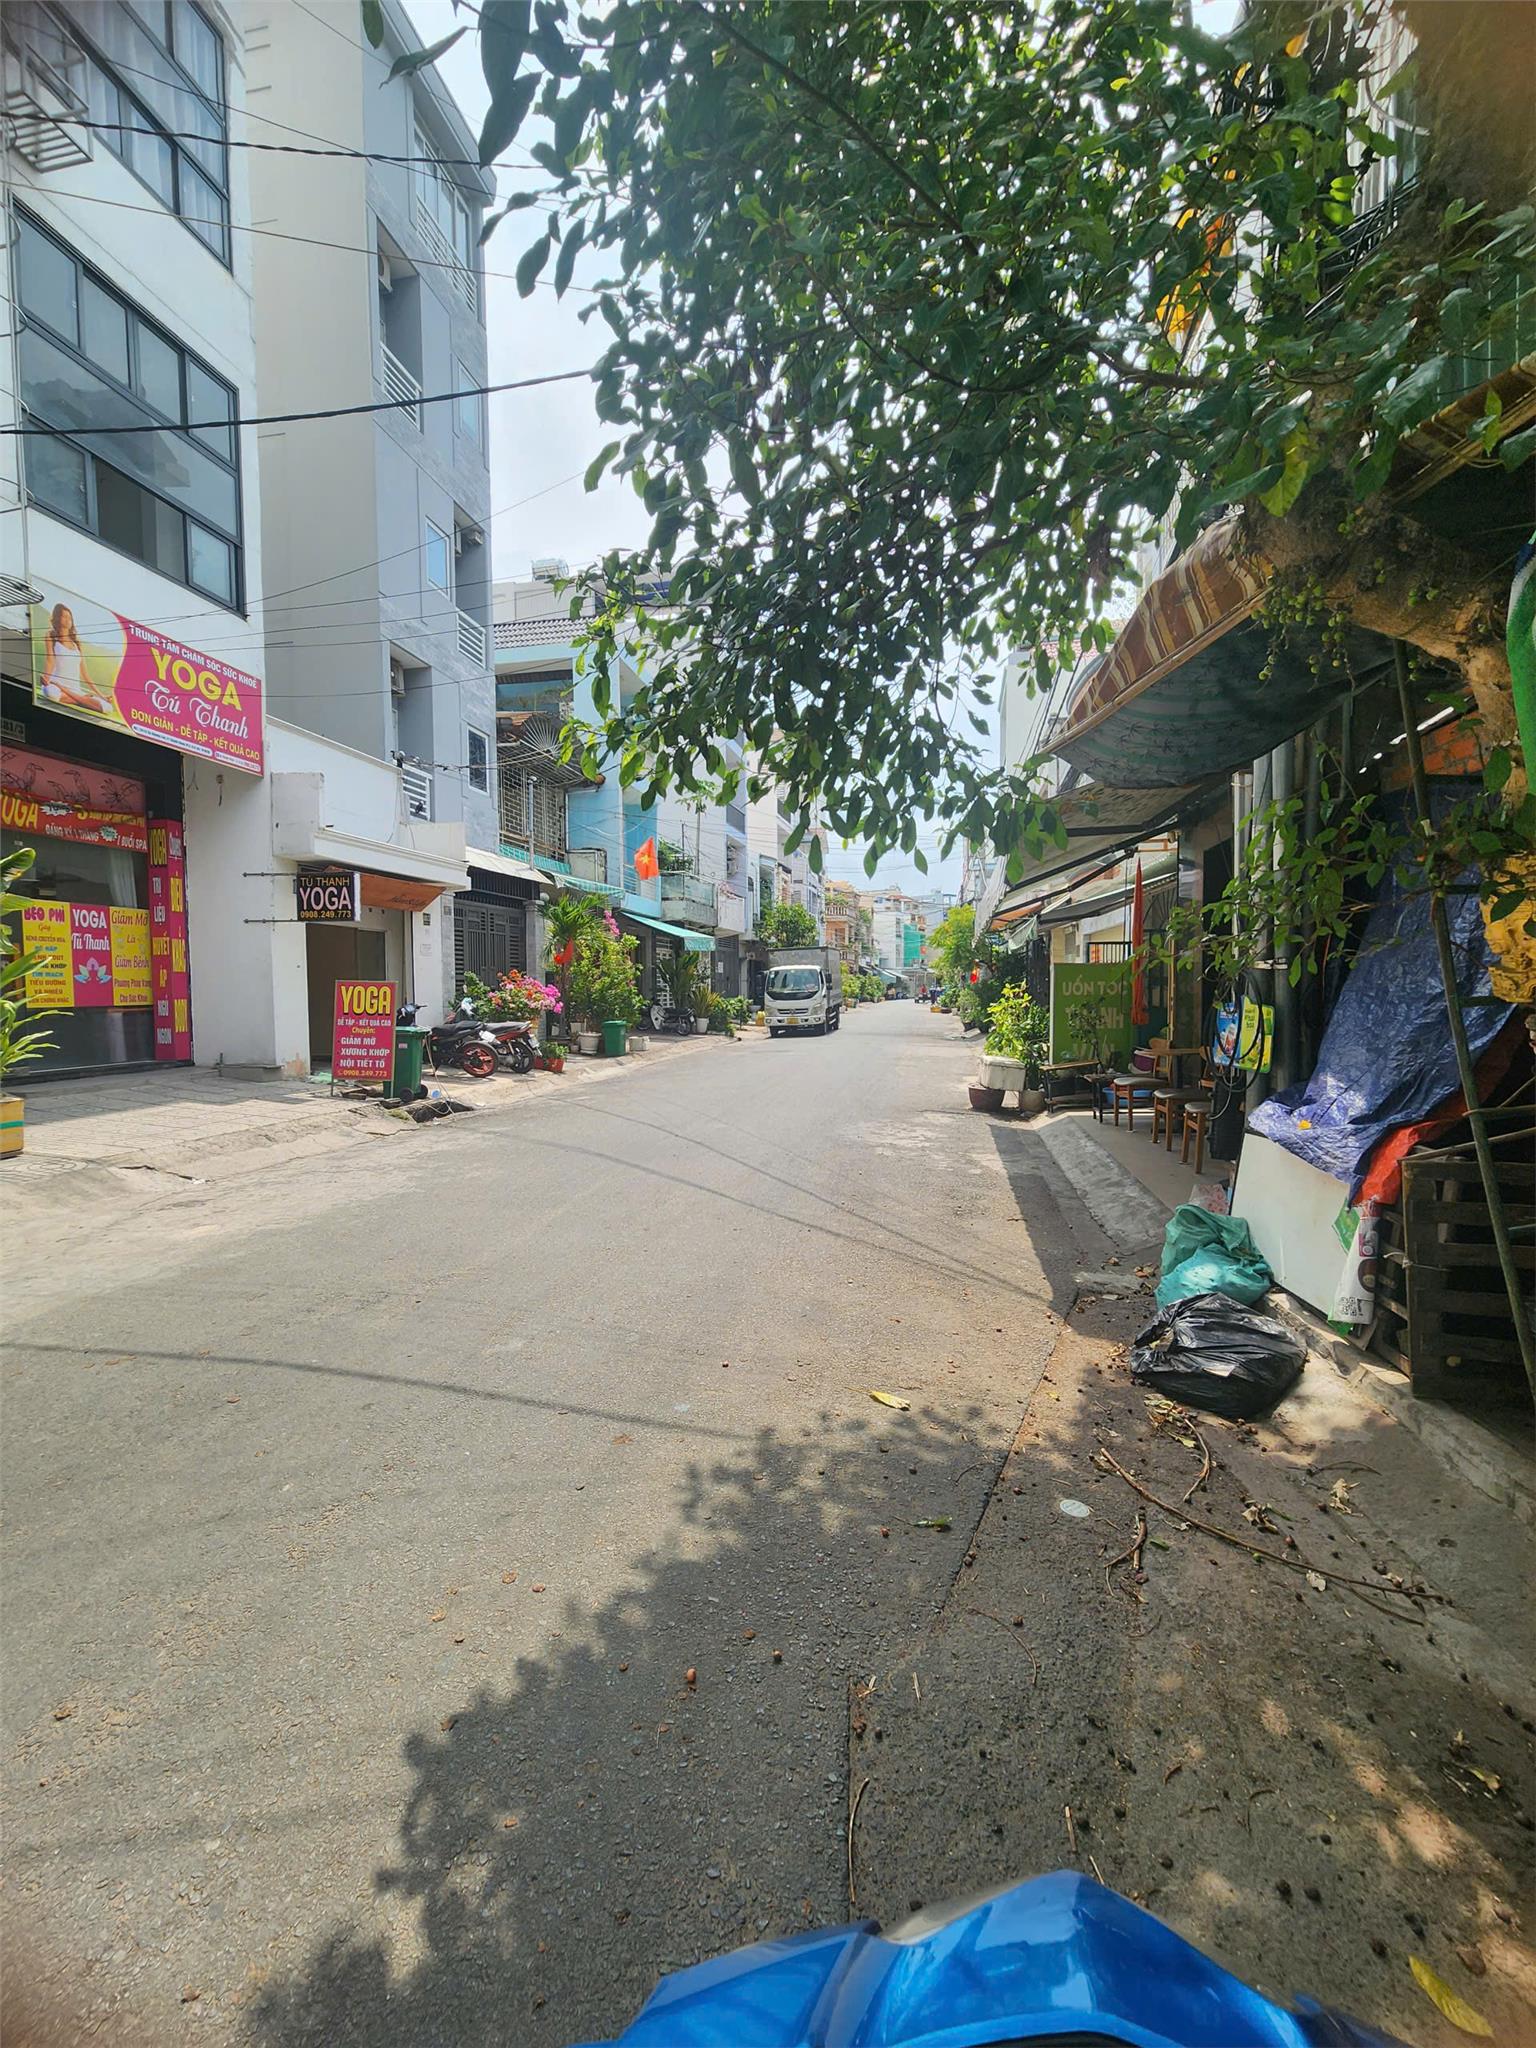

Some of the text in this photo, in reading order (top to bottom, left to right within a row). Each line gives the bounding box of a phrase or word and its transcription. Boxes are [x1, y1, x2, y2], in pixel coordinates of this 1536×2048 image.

[129, 624, 160, 646] TRUNG
[151, 647, 242, 711] YOGA
[145, 680, 248, 739] Tú Thanh
[194, 730, 208, 744] TẬP
[214, 737, 228, 750] KẾT
[229, 743, 244, 756] QUẢ
[245, 748, 260, 761] CAO
[135, 839, 148, 850] SPA
[317, 877, 350, 886] THANH
[300, 886, 352, 910] YOGA
[73, 909, 107, 929] YOGA
[84, 934, 110, 950] Thanh
[1062, 974, 1094, 996] UỐN
[341, 985, 391, 1015] YOGA
[341, 1035, 361, 1045] GIẢM
[340, 1058, 355, 1068] NỘI
[357, 1057, 373, 1068] TIẾT
[341, 1048, 367, 1056] XƯƠNG
